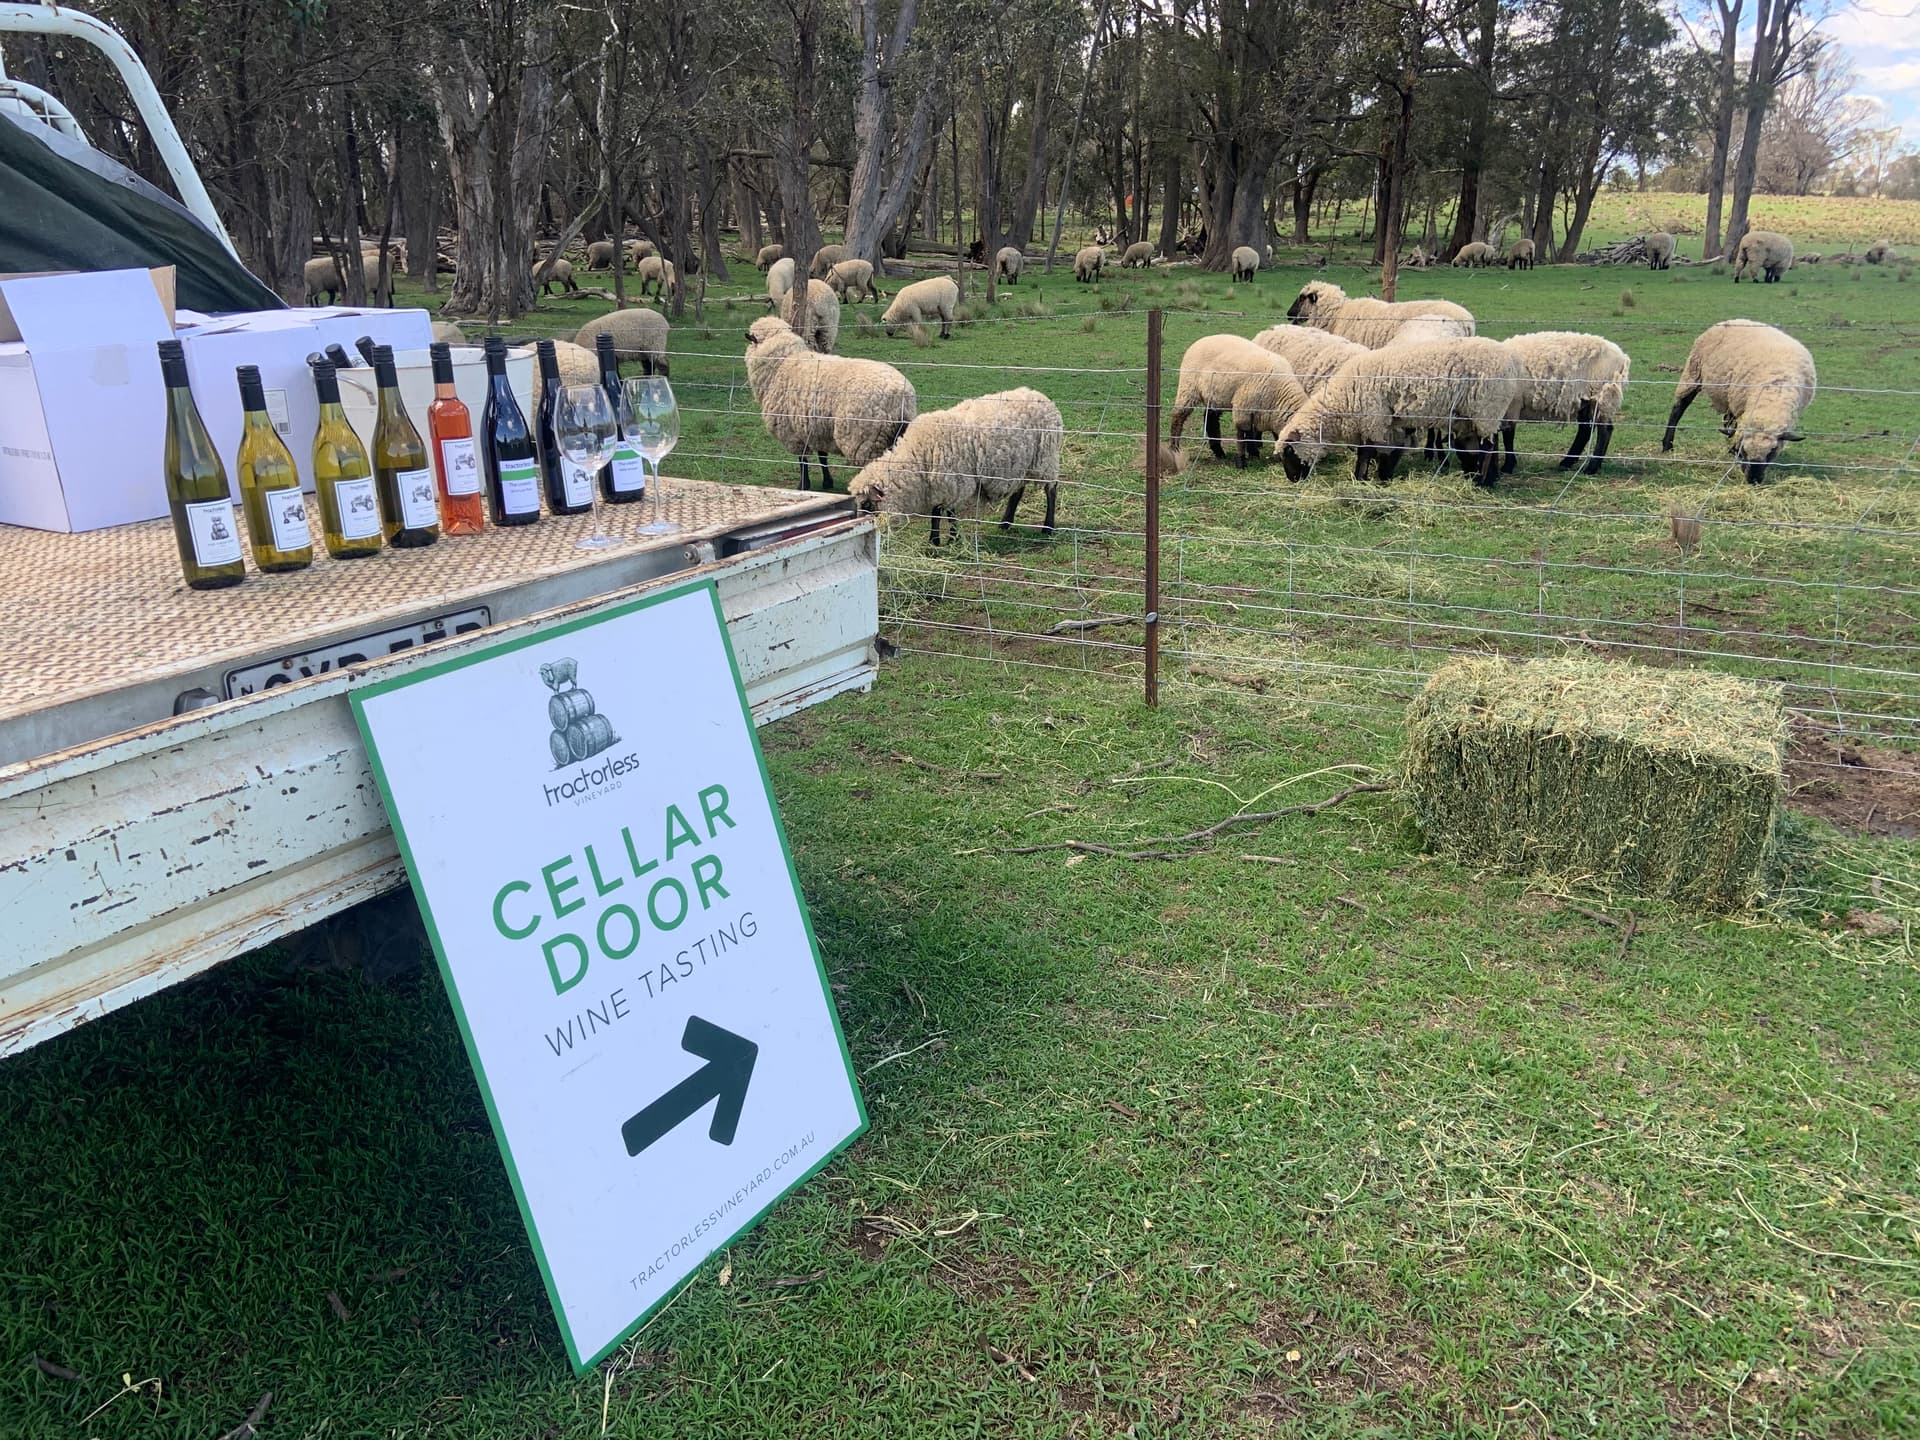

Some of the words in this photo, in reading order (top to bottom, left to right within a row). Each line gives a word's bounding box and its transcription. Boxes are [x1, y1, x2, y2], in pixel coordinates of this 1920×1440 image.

[543, 752, 640, 807] tractorless
[574, 781, 622, 807] VINEYARD
[492, 783, 737, 940] CELLAR
[541, 854, 731, 996] DOOR
[544, 988, 631, 1056] WINE
[638, 912, 759, 998] TASTING
[629, 1130, 816, 1291] TRACTORLESSVINEYARD.COM.AU
